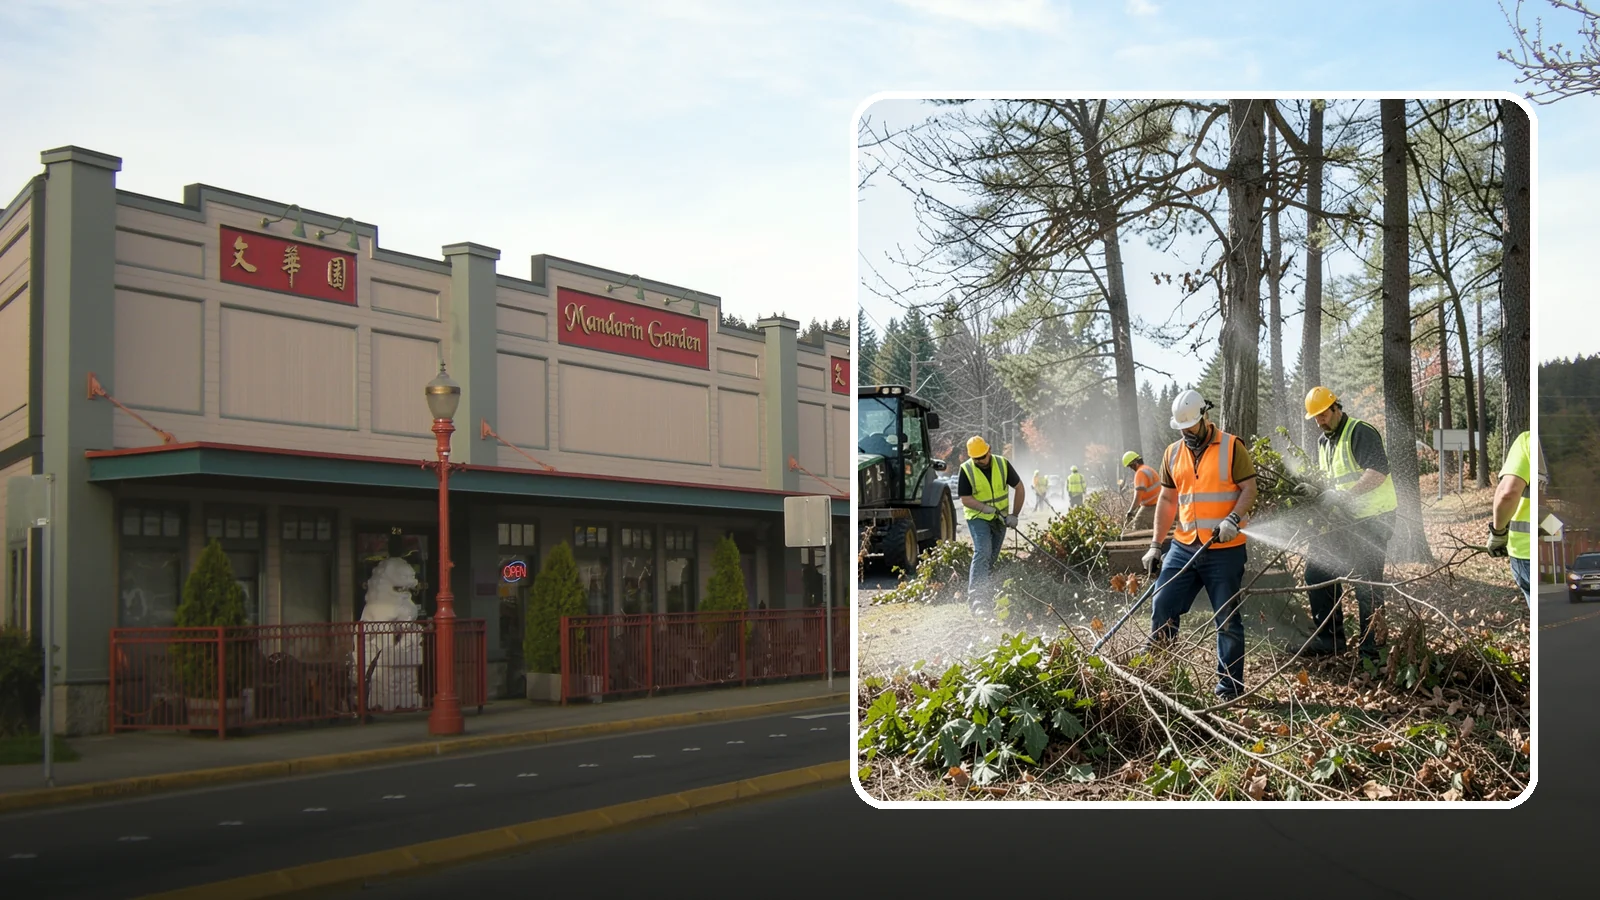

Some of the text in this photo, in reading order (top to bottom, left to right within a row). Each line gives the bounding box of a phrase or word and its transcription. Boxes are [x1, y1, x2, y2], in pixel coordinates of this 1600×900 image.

[231, 236, 346, 291] 文華園
[564, 302, 701, 352] Mandarin Garden
[503, 562, 527, 577] OPEN
